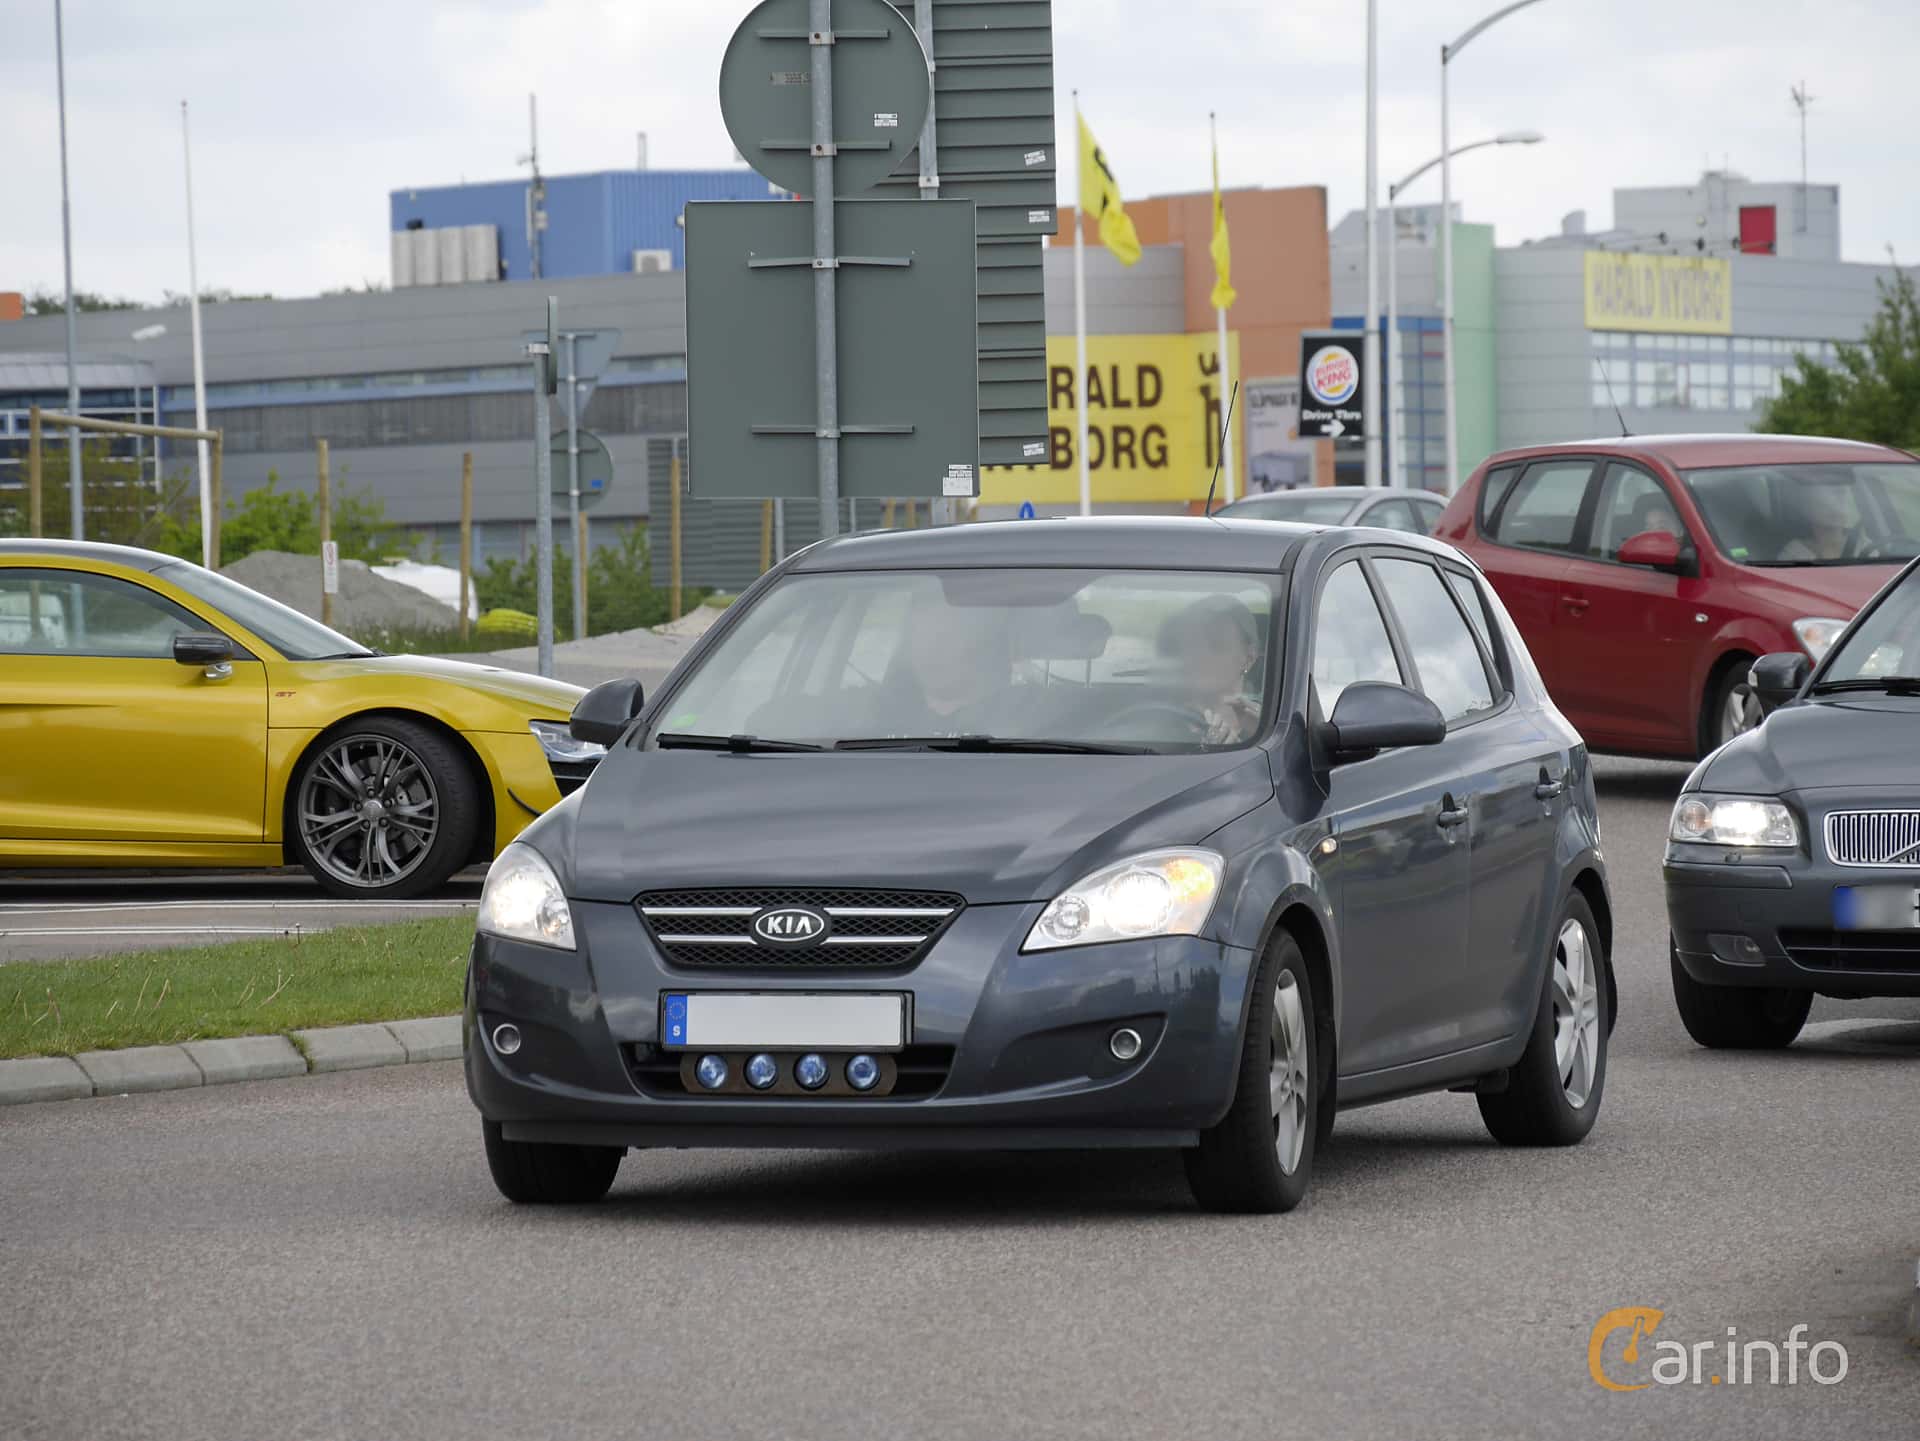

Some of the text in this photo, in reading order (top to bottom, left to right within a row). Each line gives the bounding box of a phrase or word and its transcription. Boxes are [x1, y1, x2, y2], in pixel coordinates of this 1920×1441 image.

[1050, 364, 1163, 410] RALD
[1315, 367, 1352, 388] KING
[766, 915, 813, 934] KIA
[672, 1025, 681, 1037] S
